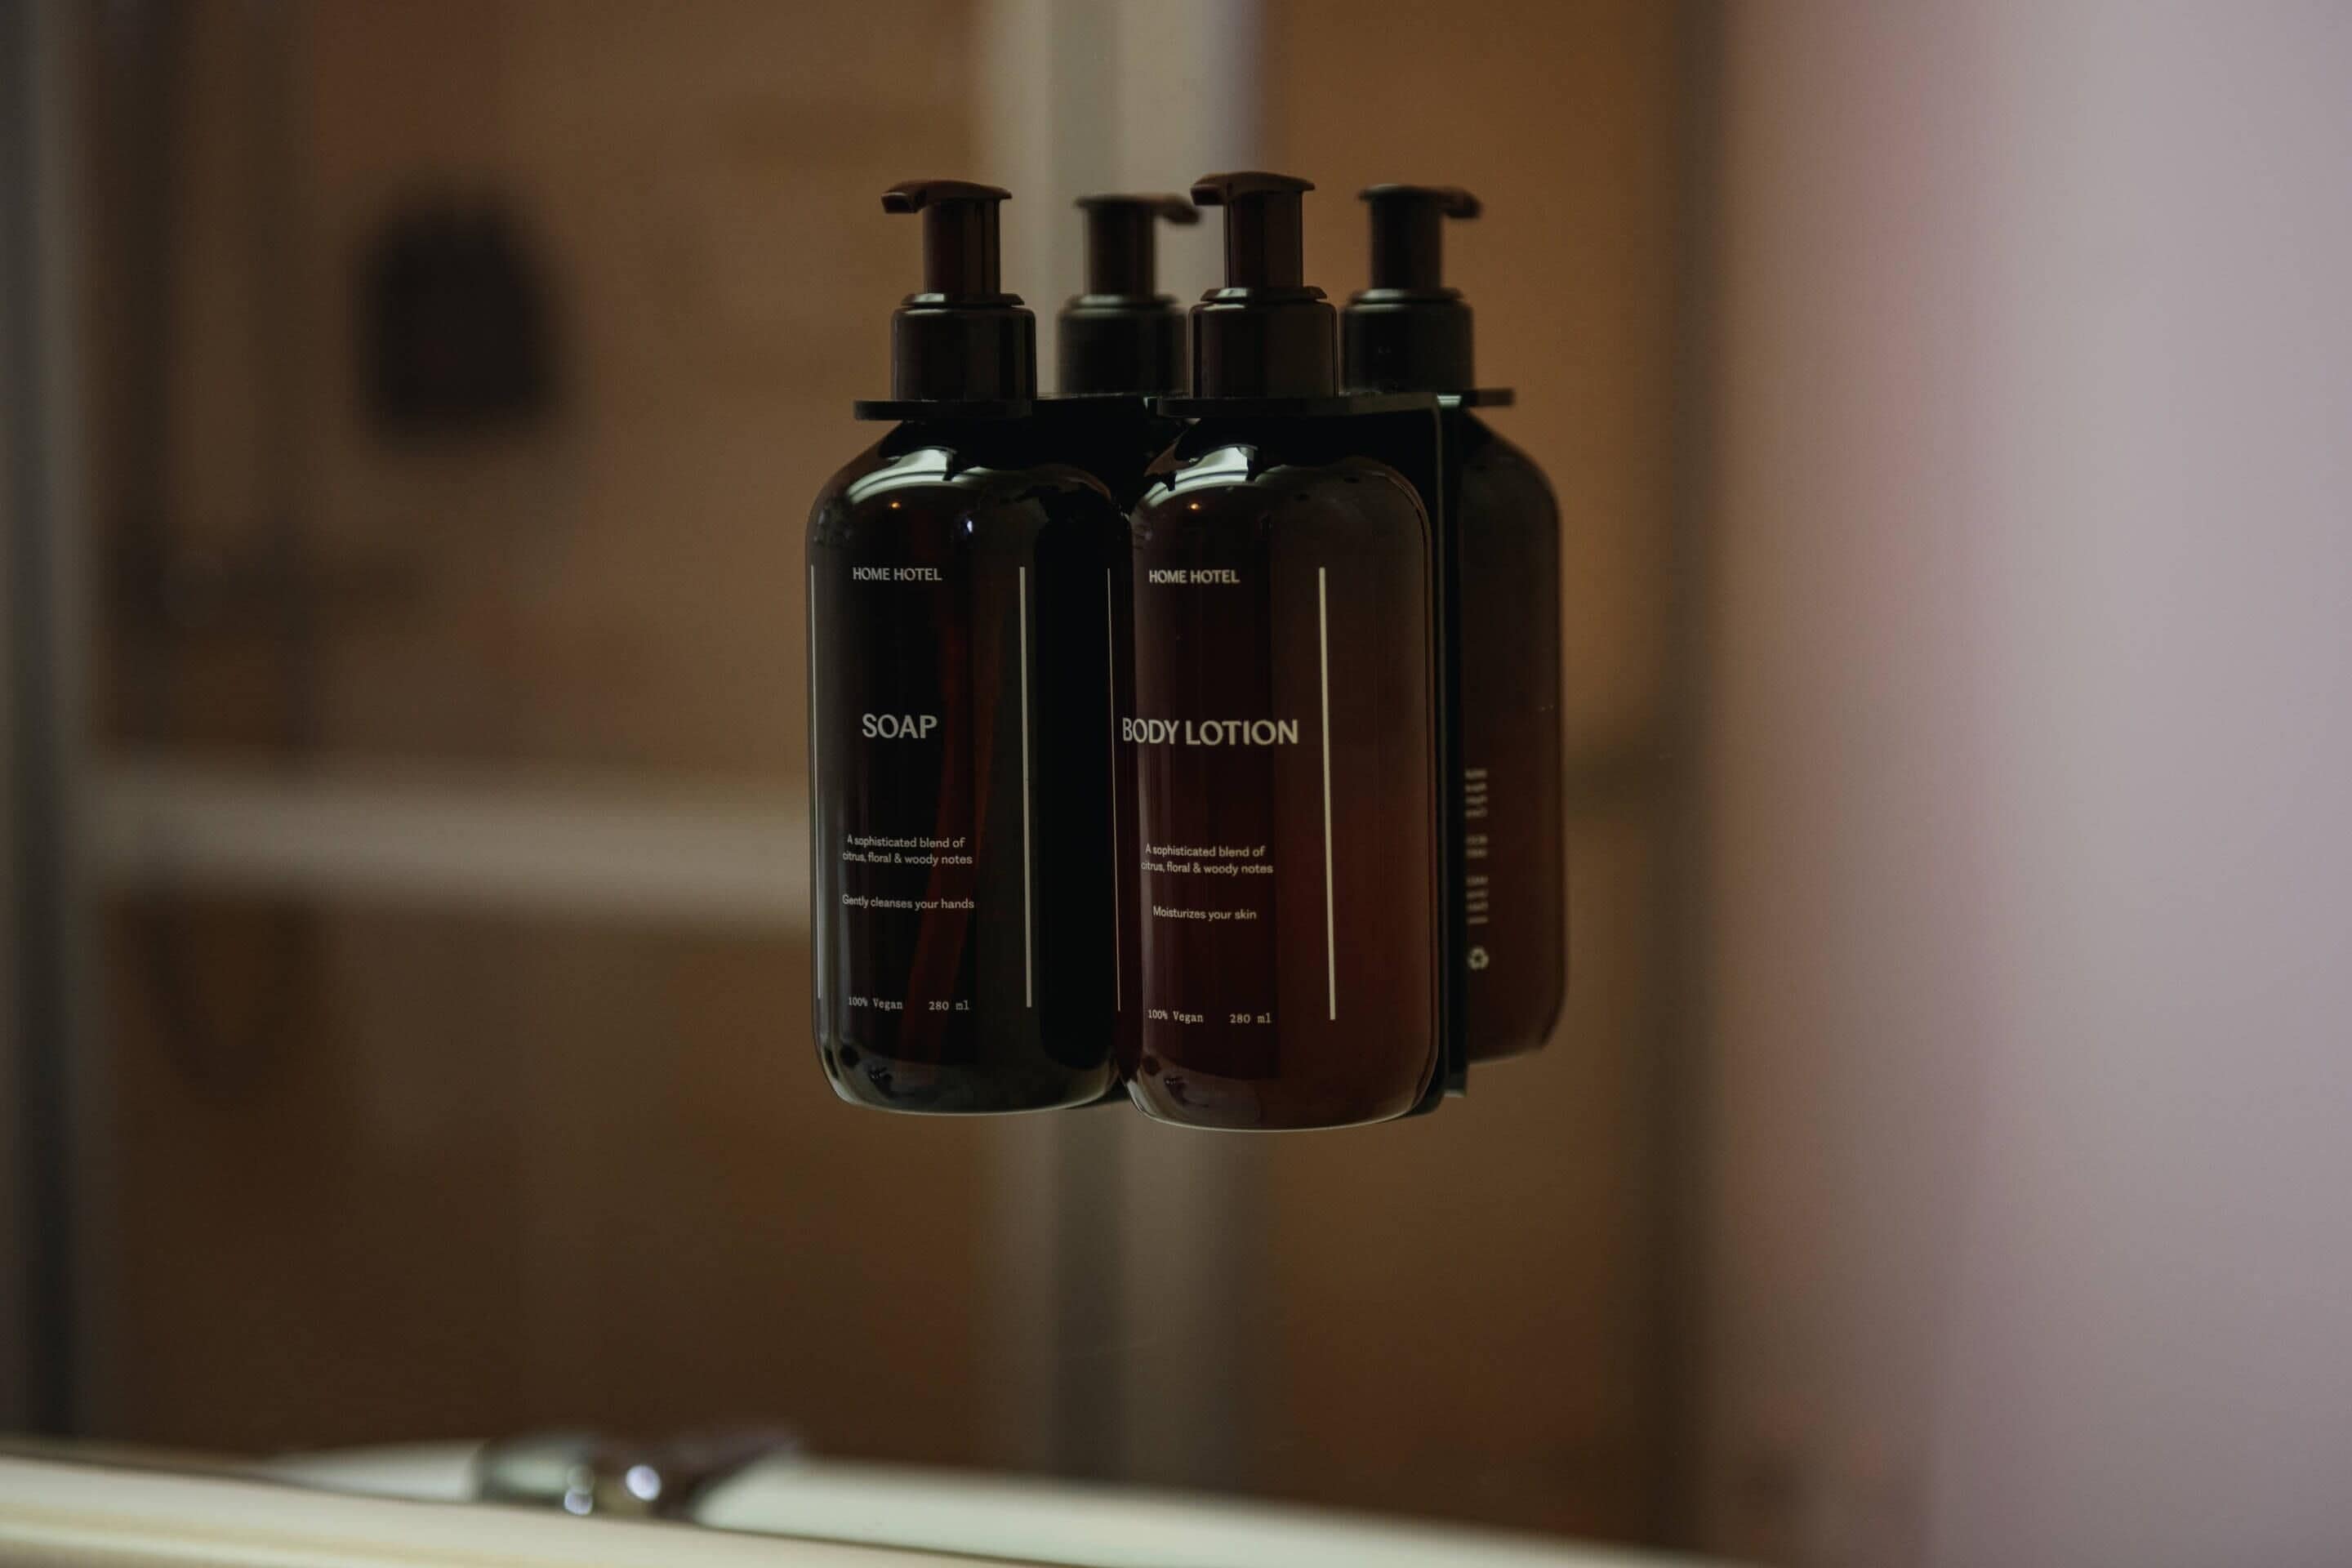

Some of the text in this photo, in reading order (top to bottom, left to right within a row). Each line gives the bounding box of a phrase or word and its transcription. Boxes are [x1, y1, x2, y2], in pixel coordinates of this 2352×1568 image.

[853, 567, 943, 581] HOME HOTEL
[1148, 568, 1241, 584] HOME HOTEL
[862, 713, 938, 738] SOAP
[1122, 717, 1298, 746] BODY LOTION
[847, 834, 966, 850] A sophisticated blend of
[1145, 843, 1266, 859] A sophisticated blend of
[842, 852, 973, 867] citrus, floral & woody notes
[1140, 861, 1274, 876] citrus, floral & woody notes
[842, 894, 975, 911] Gently cleanses your hands
[1152, 905, 1257, 922] Moisturizes your skin
[849, 996, 903, 1012] 100% Vegan
[929, 1000, 969, 1011] 280 ml
[1147, 1009, 1204, 1025] 100% Vegan
[1229, 1012, 1272, 1024] 280 ml
